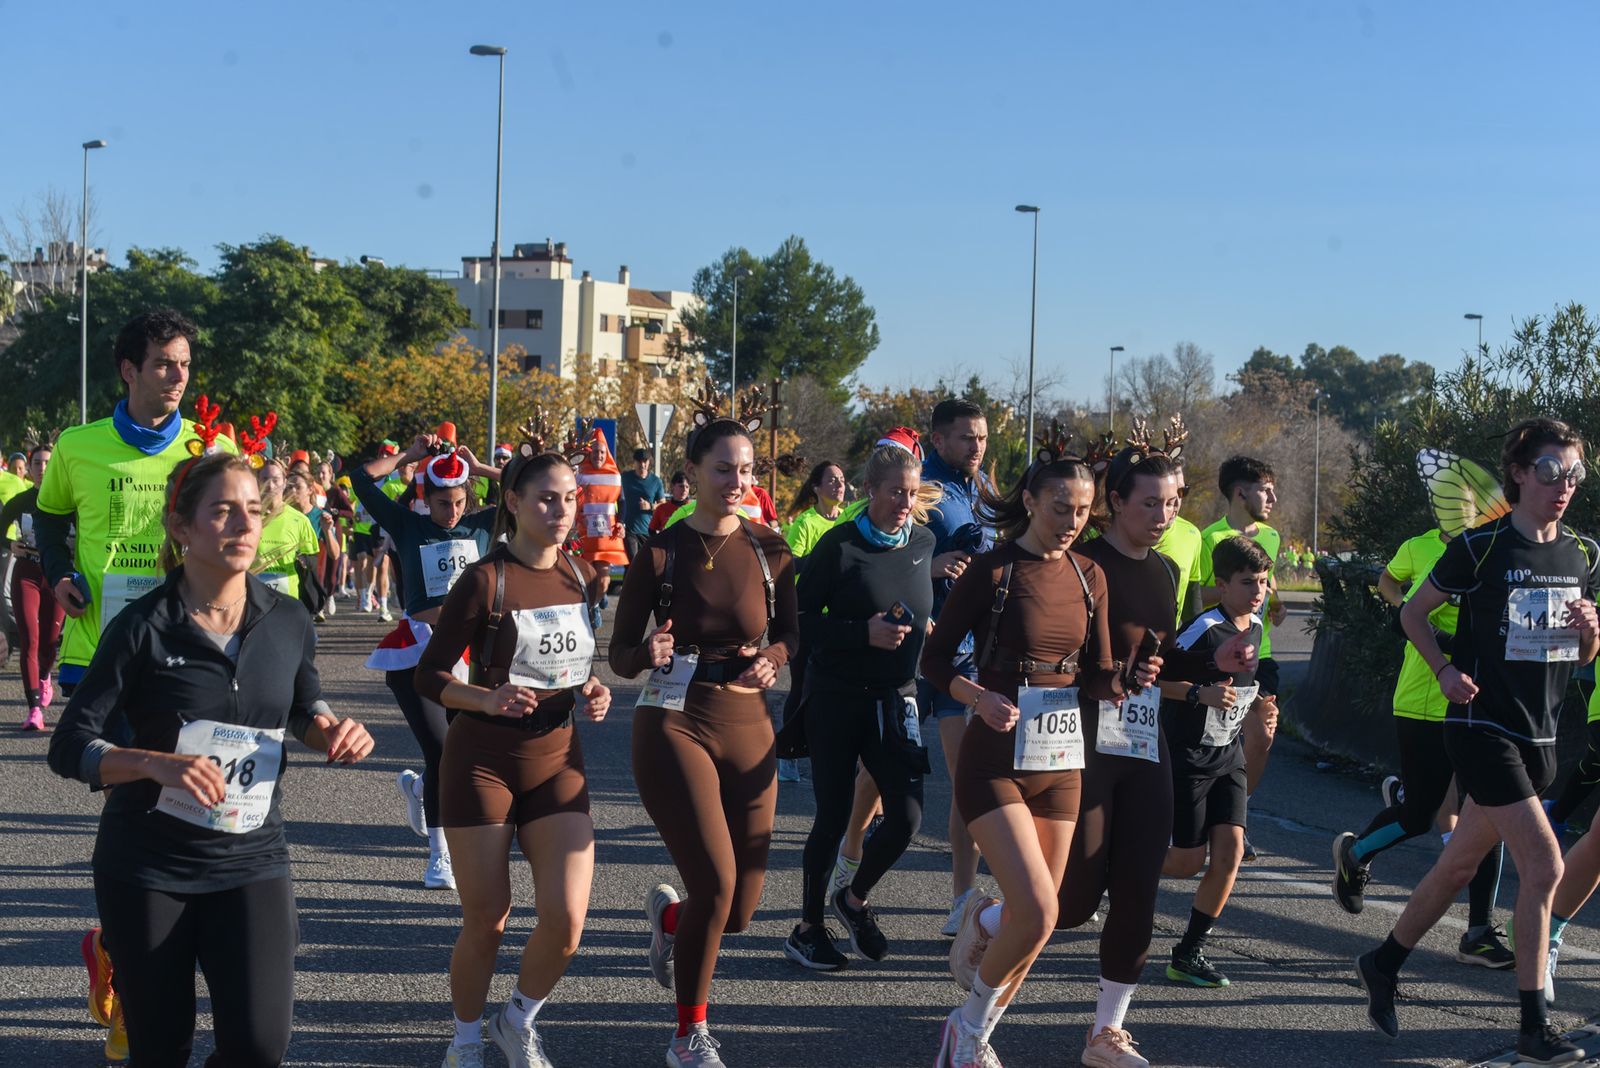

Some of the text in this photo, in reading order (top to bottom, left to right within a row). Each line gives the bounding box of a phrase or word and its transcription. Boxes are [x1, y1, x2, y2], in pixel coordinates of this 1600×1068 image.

[105, 543, 128, 554] SAN
[112, 558, 157, 569] CORDO
[437, 555, 467, 572] 618
[1531, 575, 1579, 584] ANIVERSARIO
[538, 630, 577, 655] 536
[1118, 702, 1155, 727] 1538
[1034, 712, 1077, 734] 1058
[173, 799, 206, 815] IMDECO
